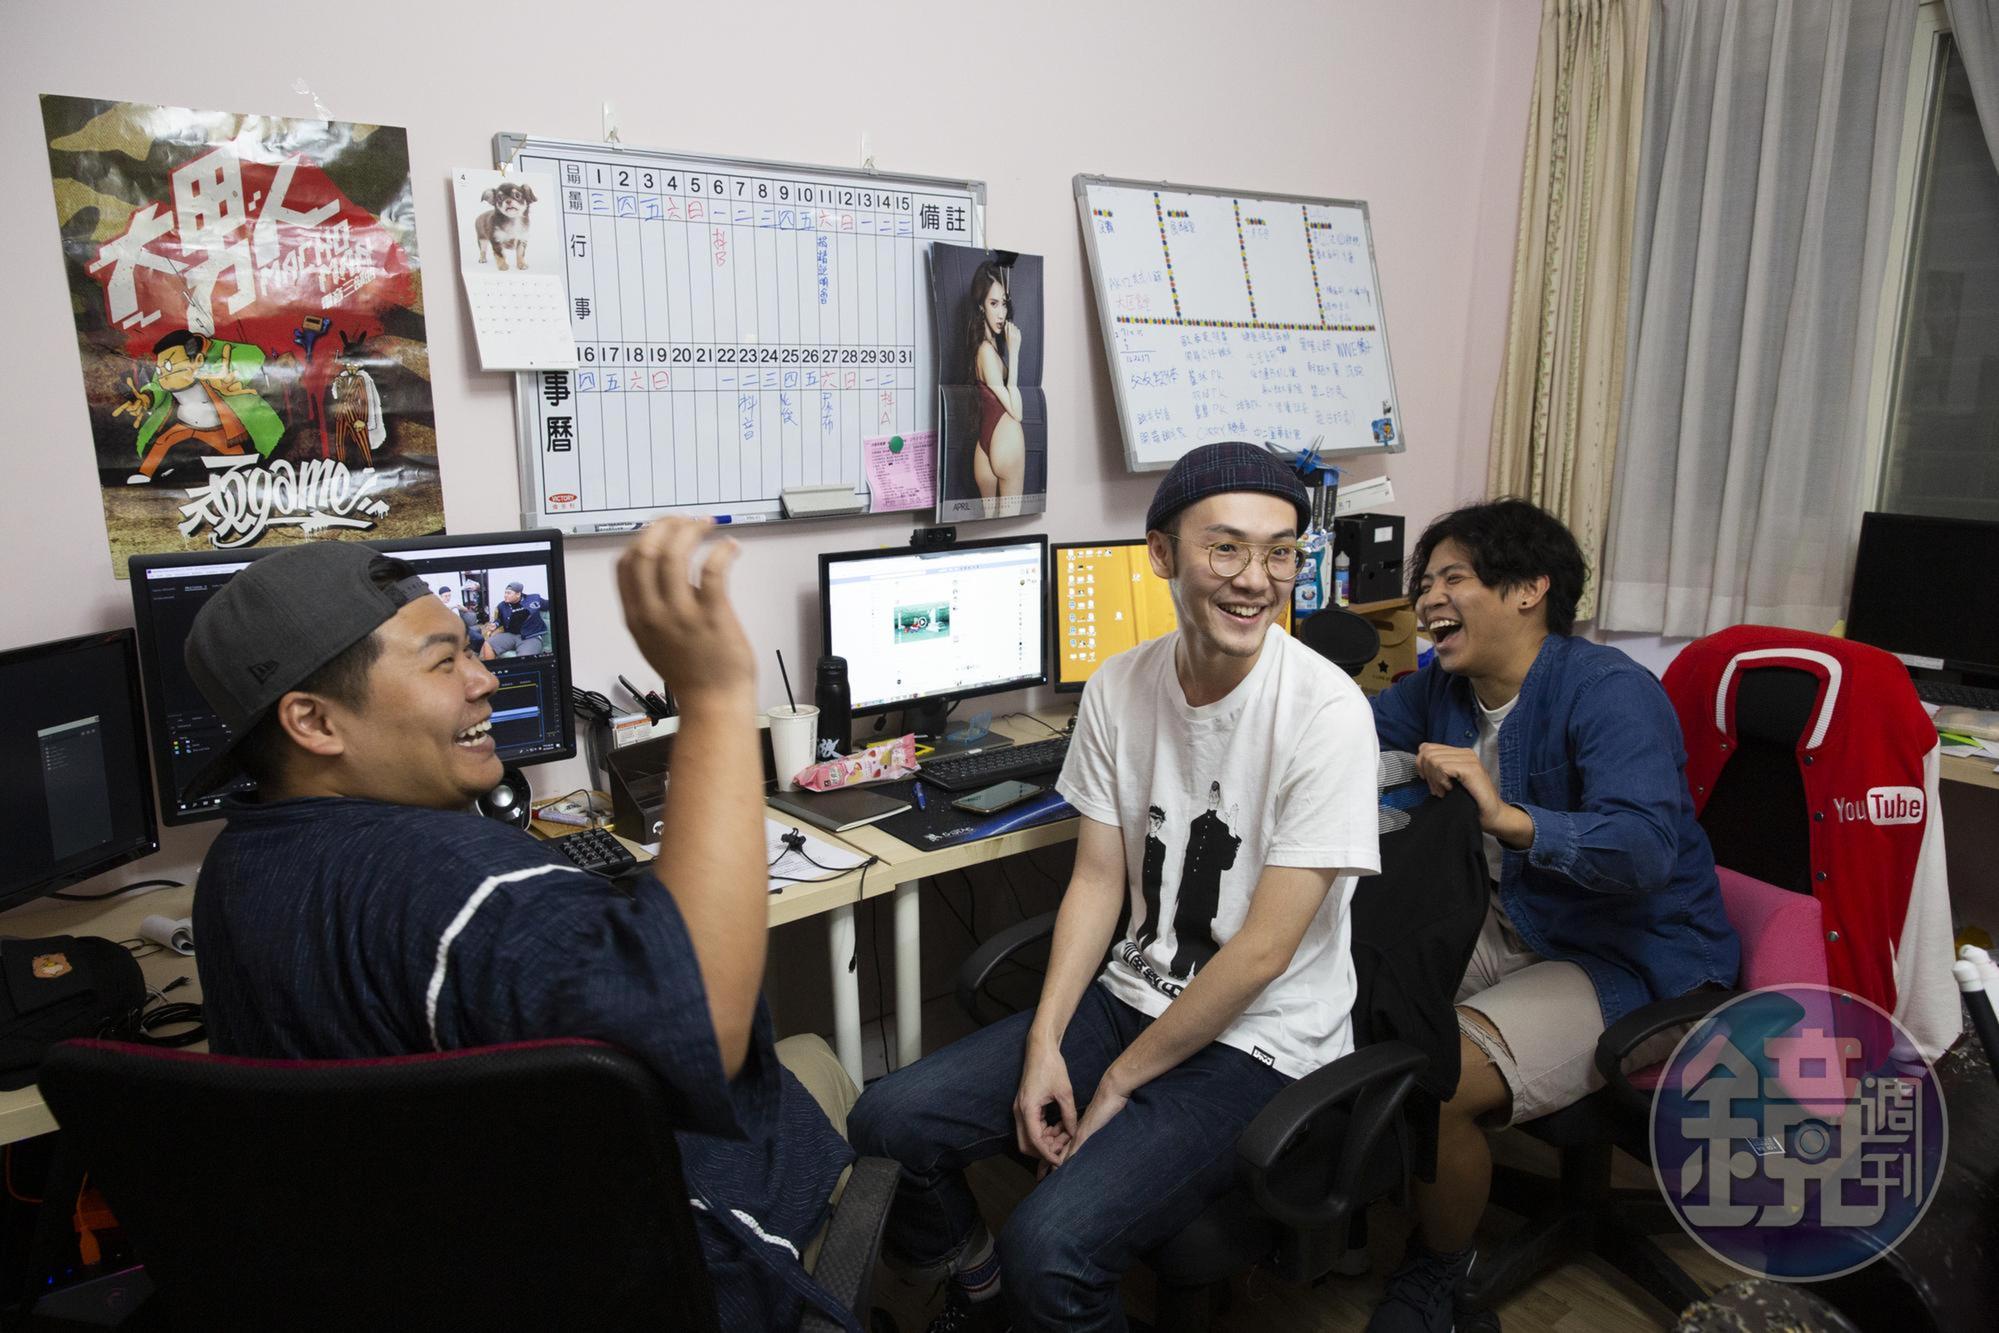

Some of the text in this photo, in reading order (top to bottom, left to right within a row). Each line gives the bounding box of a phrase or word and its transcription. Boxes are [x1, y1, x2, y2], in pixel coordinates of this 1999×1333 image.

[567, 165, 581, 184] 日期
[569, 191, 583, 210] 星期
[597, 169, 910, 210] 1 2 3 4 5 6 7 8 9 10 11 12 13 14 15
[592, 193, 610, 210] 三
[617, 195, 637, 217] 四
[640, 197, 664, 221] 五
[667, 197, 681, 219] 六
[688, 200, 703, 219] 日
[735, 210, 753, 221] 二
[799, 211, 816, 230] 五
[818, 209, 832, 227] 六
[841, 214, 853, 231] 日
[879, 220, 892, 231] 二
[897, 221, 912, 235] 三
[919, 203, 966, 231] 備註
[577, 346, 912, 363] 16 17 18 19 20 21 22 23 24 25 26 27 28 29 30 31
[579, 371, 596, 392] 四
[604, 373, 621, 392] 五
[630, 371, 645, 390] 六
[652, 370, 669, 390] 日
[743, 374, 760, 386] 二
[762, 372, 778, 388] 三
[784, 371, 798, 388] 四
[805, 371, 819, 387] 五
[821, 371, 838, 388] 六
[845, 371, 856, 390] 日
[880, 374, 895, 386] 二
[551, 495, 575, 503] VICTORY
[1833, 792, 1921, 823] YouTube
